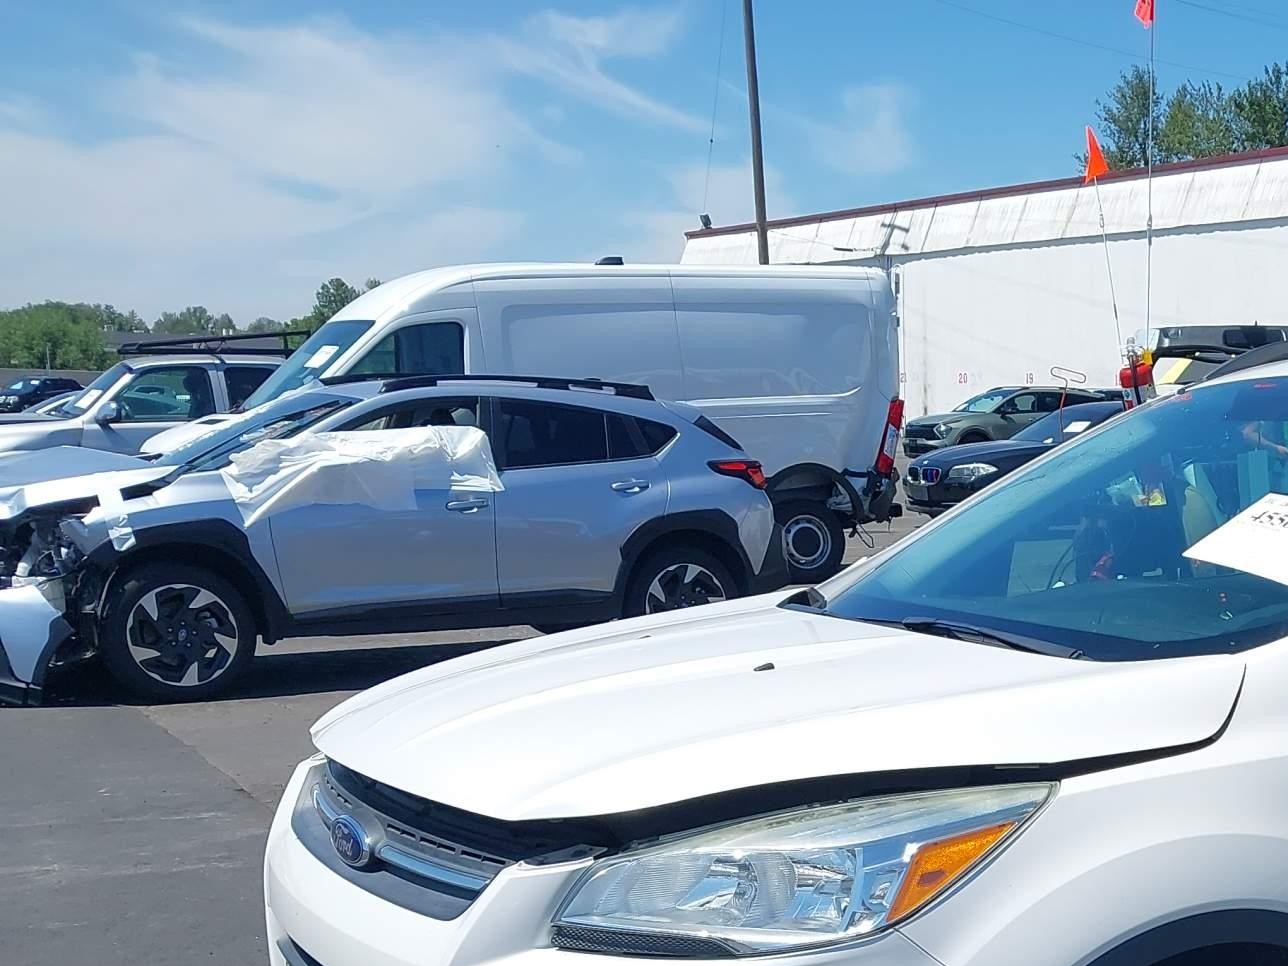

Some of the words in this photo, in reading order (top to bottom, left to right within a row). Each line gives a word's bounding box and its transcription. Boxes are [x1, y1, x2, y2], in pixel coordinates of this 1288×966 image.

[958, 372, 968, 384] 20
[1025, 372, 1034, 385] 19
[335, 822, 354, 857] Ford
